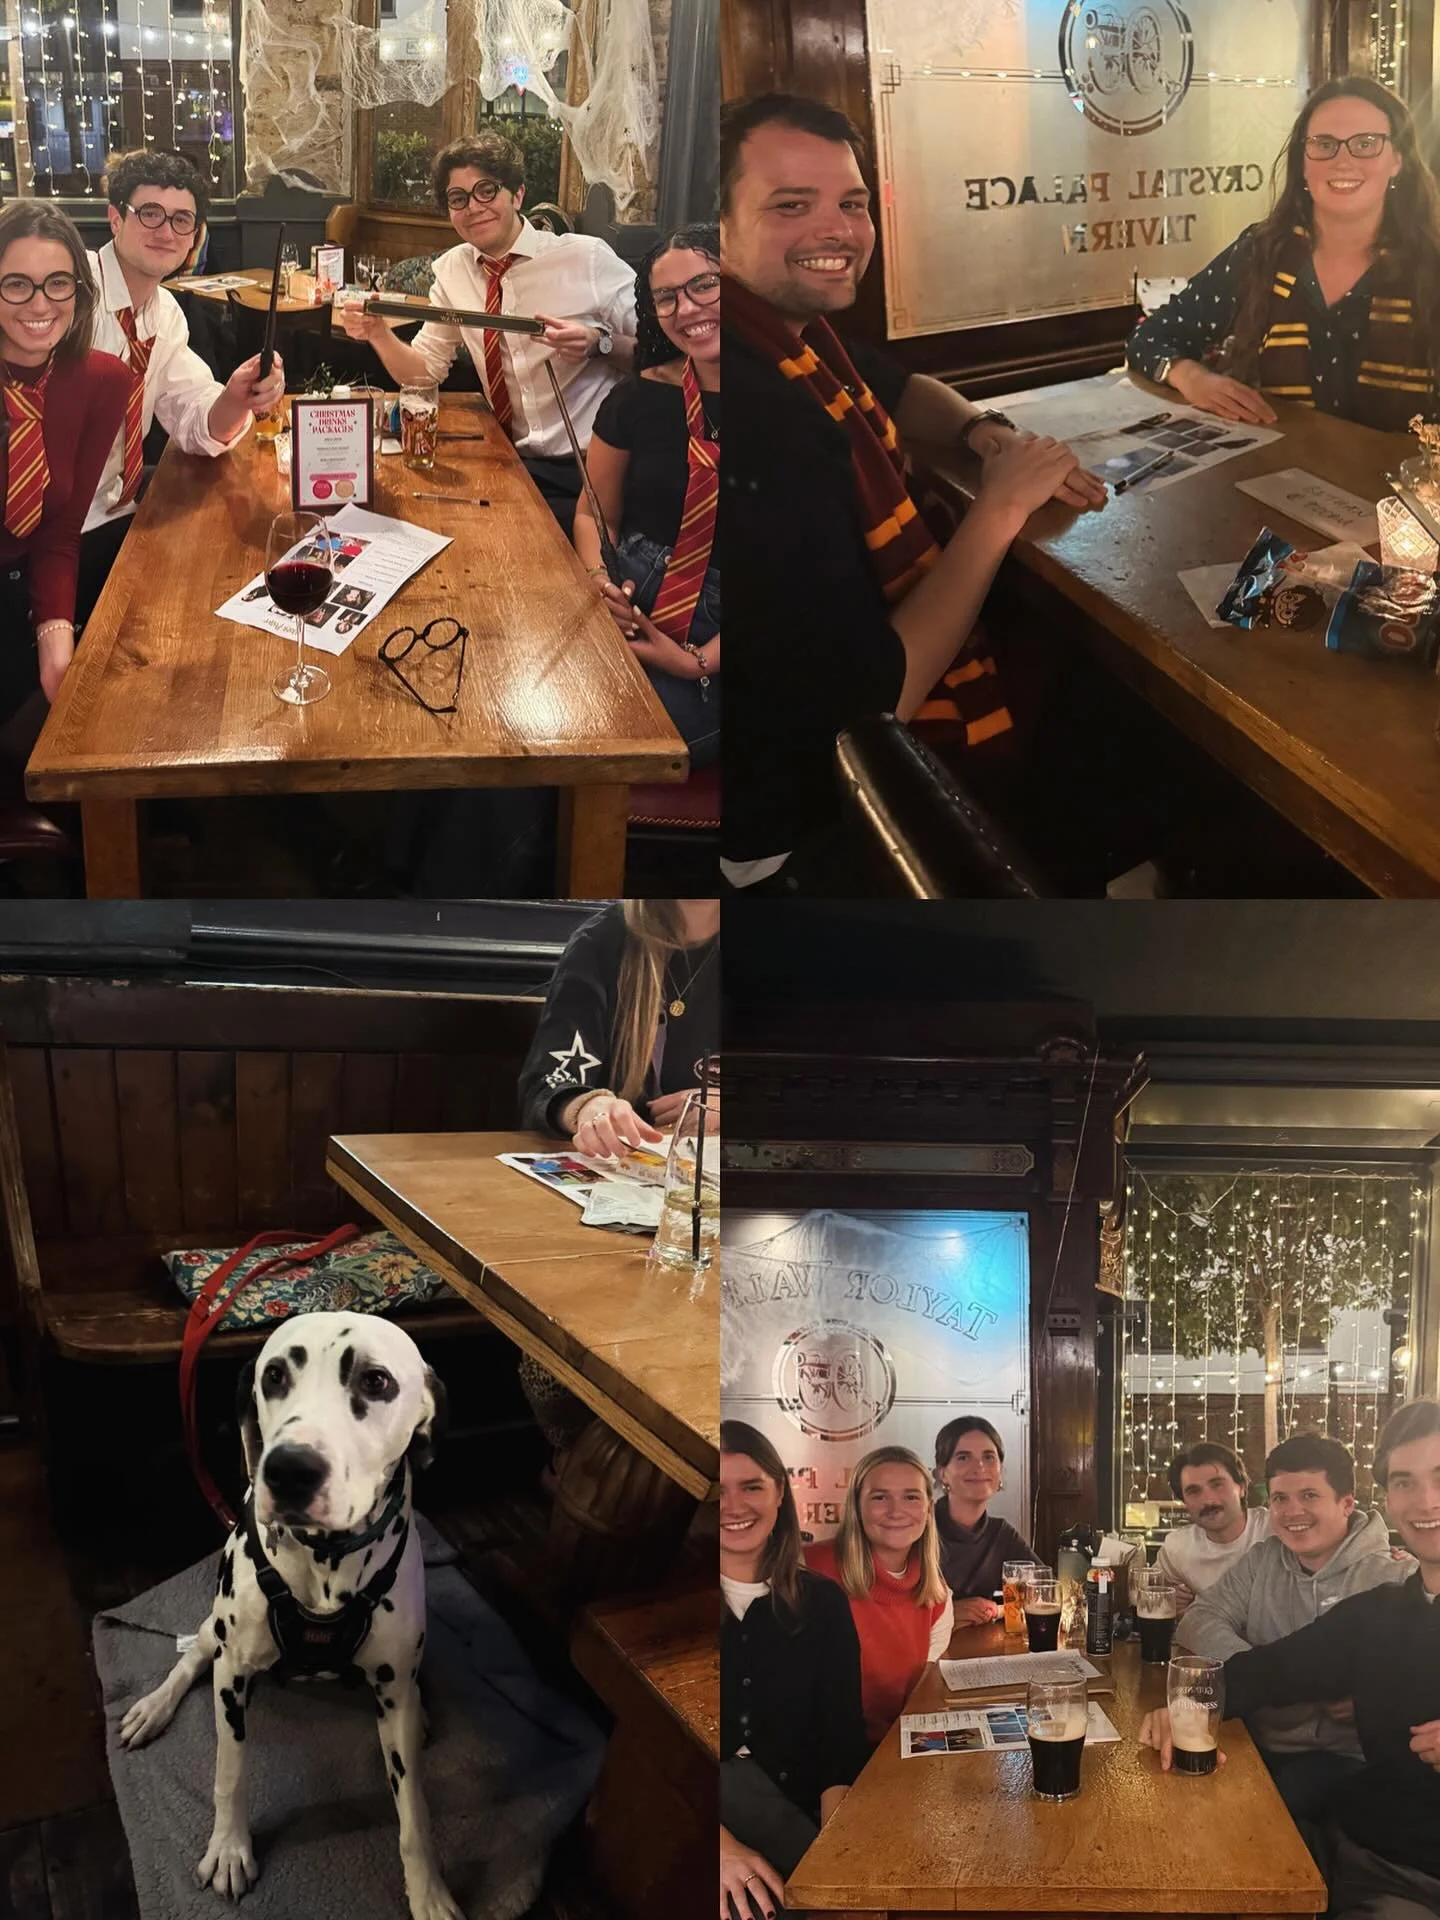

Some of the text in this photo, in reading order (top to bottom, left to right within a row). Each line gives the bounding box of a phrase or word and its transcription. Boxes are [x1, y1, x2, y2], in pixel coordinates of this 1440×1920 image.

[310, 409, 356, 418] CHRISTMAS
[319, 418, 347, 426] DRINKS
[312, 425, 354, 434] PACKAGES
